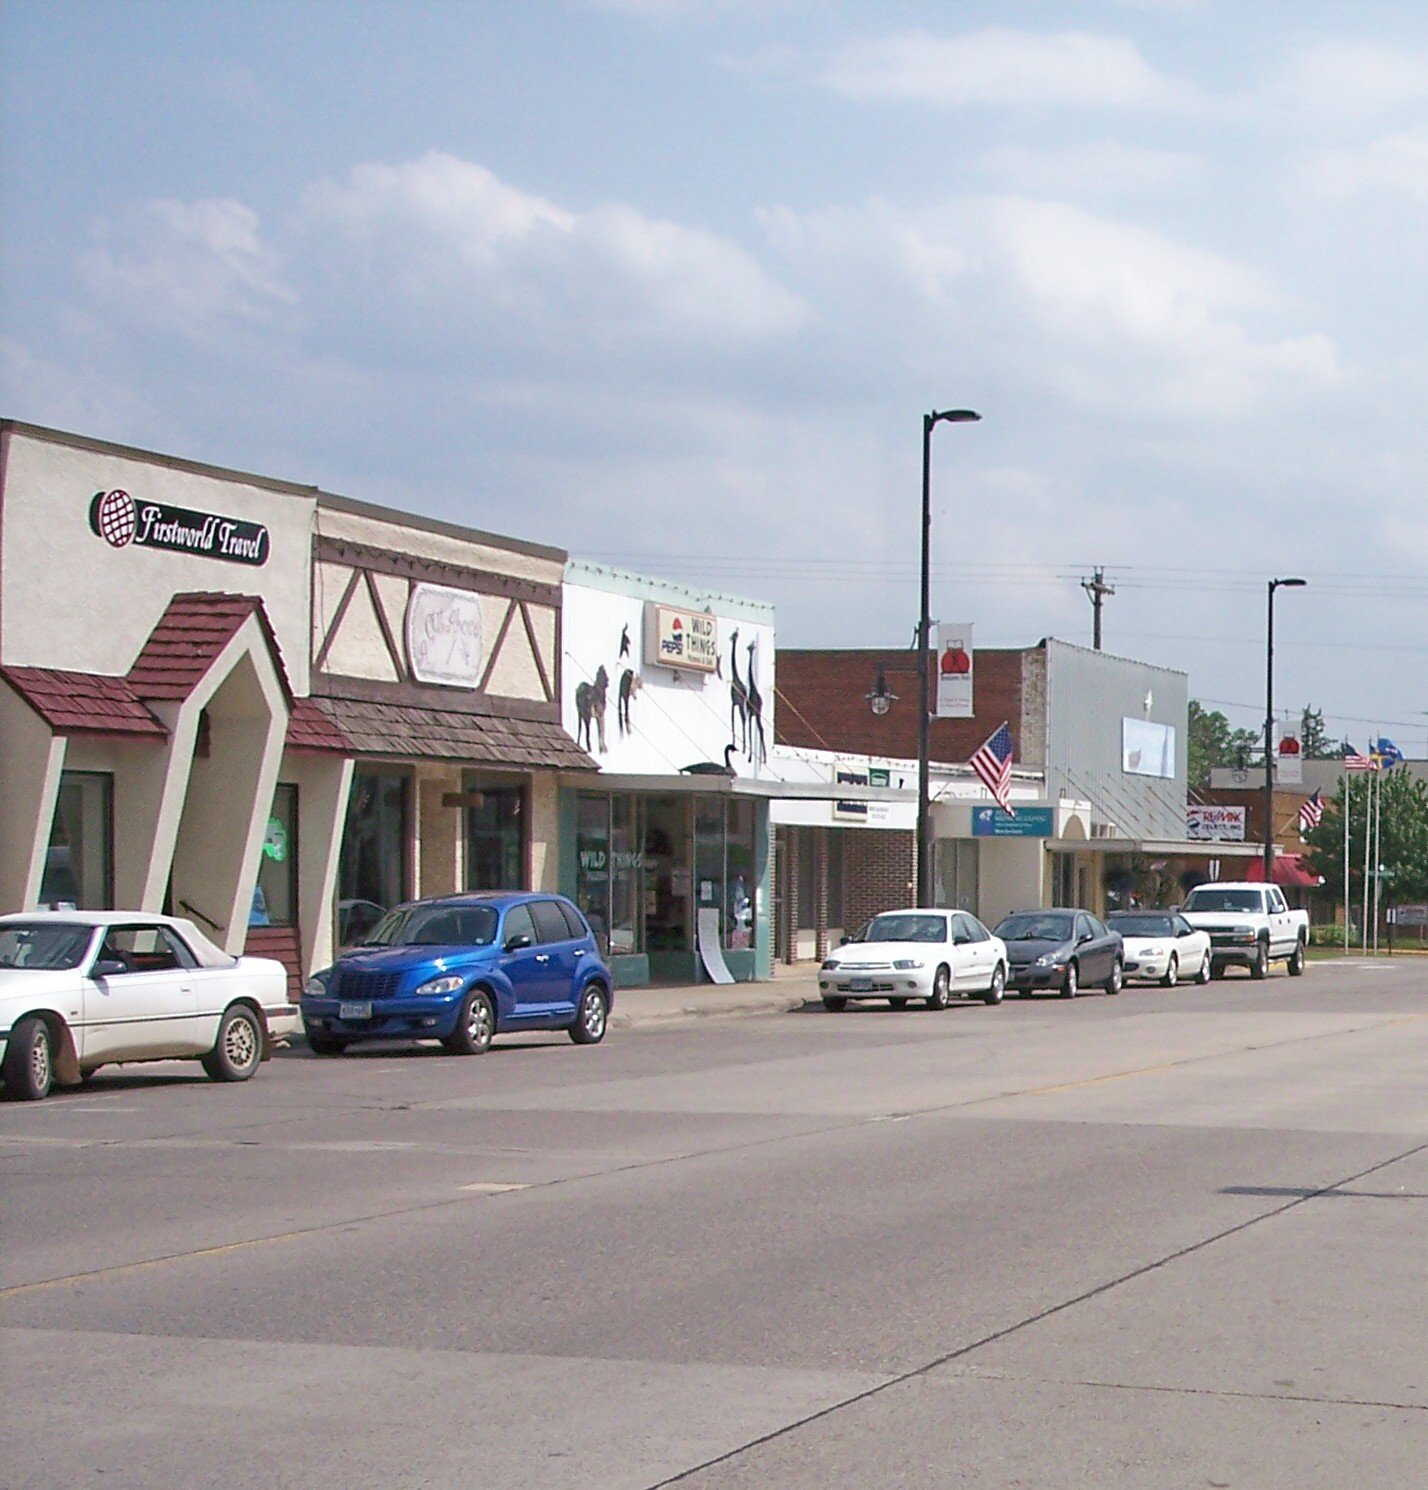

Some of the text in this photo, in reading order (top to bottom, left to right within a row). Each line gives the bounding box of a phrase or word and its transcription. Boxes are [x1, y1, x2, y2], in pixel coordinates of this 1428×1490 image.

[135, 506, 265, 558] Firstworld Travel
[691, 618, 713, 636] WILD
[662, 640, 683, 655] PEPSI
[686, 633, 716, 656] THINGS
[580, 850, 606, 869] WILD
